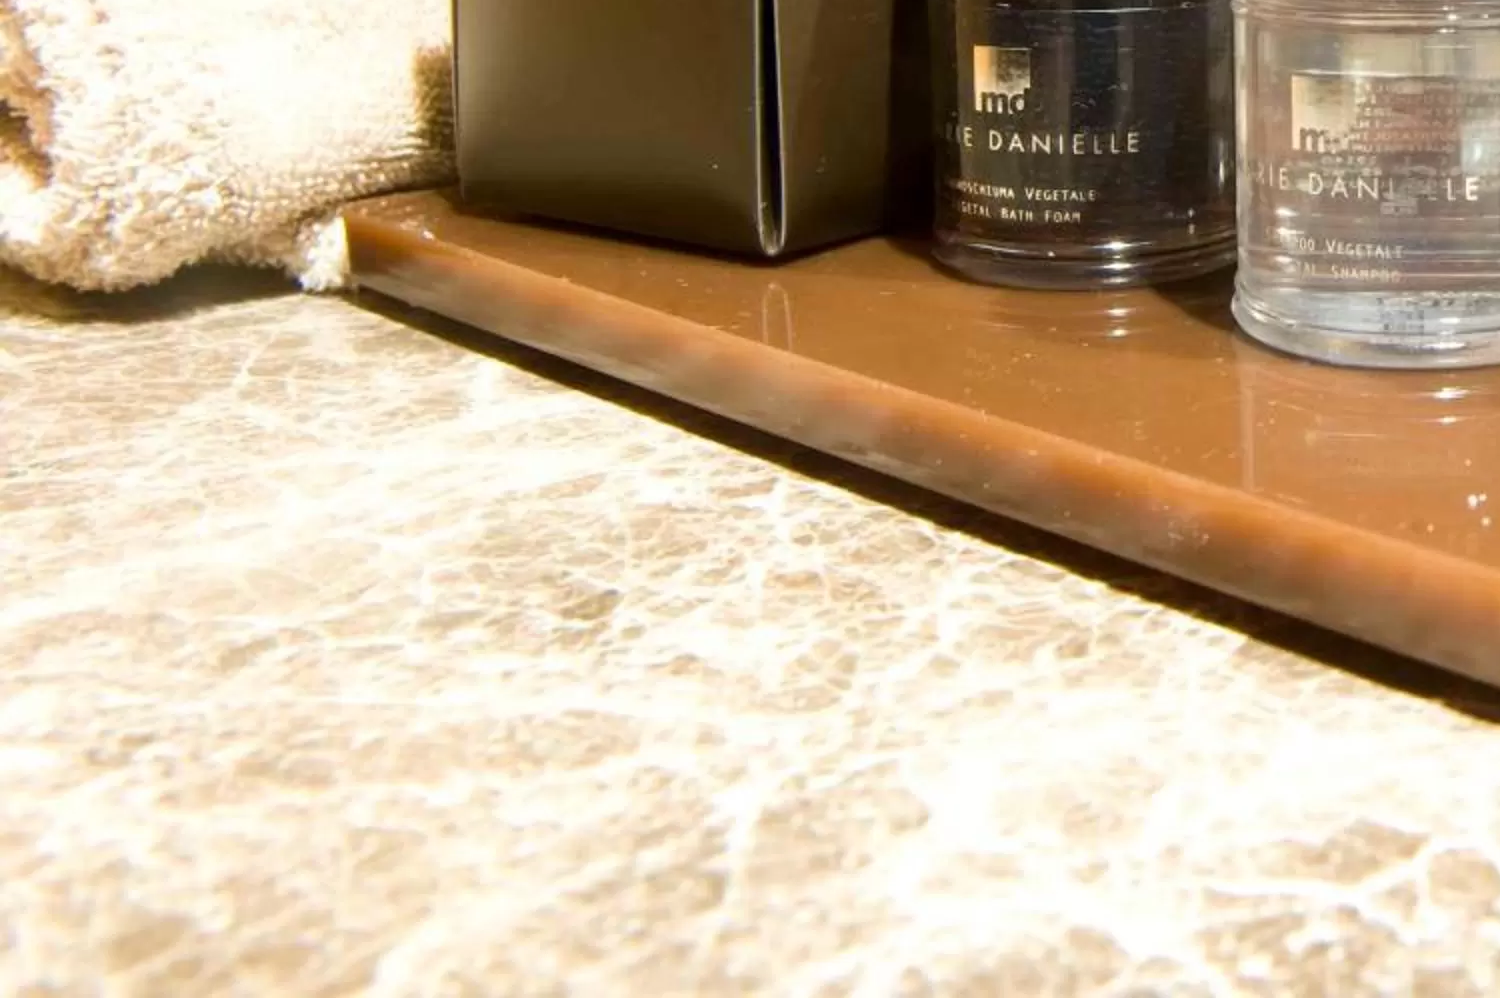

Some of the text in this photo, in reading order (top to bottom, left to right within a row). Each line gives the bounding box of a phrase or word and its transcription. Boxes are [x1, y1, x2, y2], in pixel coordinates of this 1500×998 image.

[988, 128, 1141, 155] DANIELLE
[1024, 186, 1097, 203] VEGETALE
[1000, 206, 1034, 222] BATH
[1044, 211, 1082, 224] FOAM
